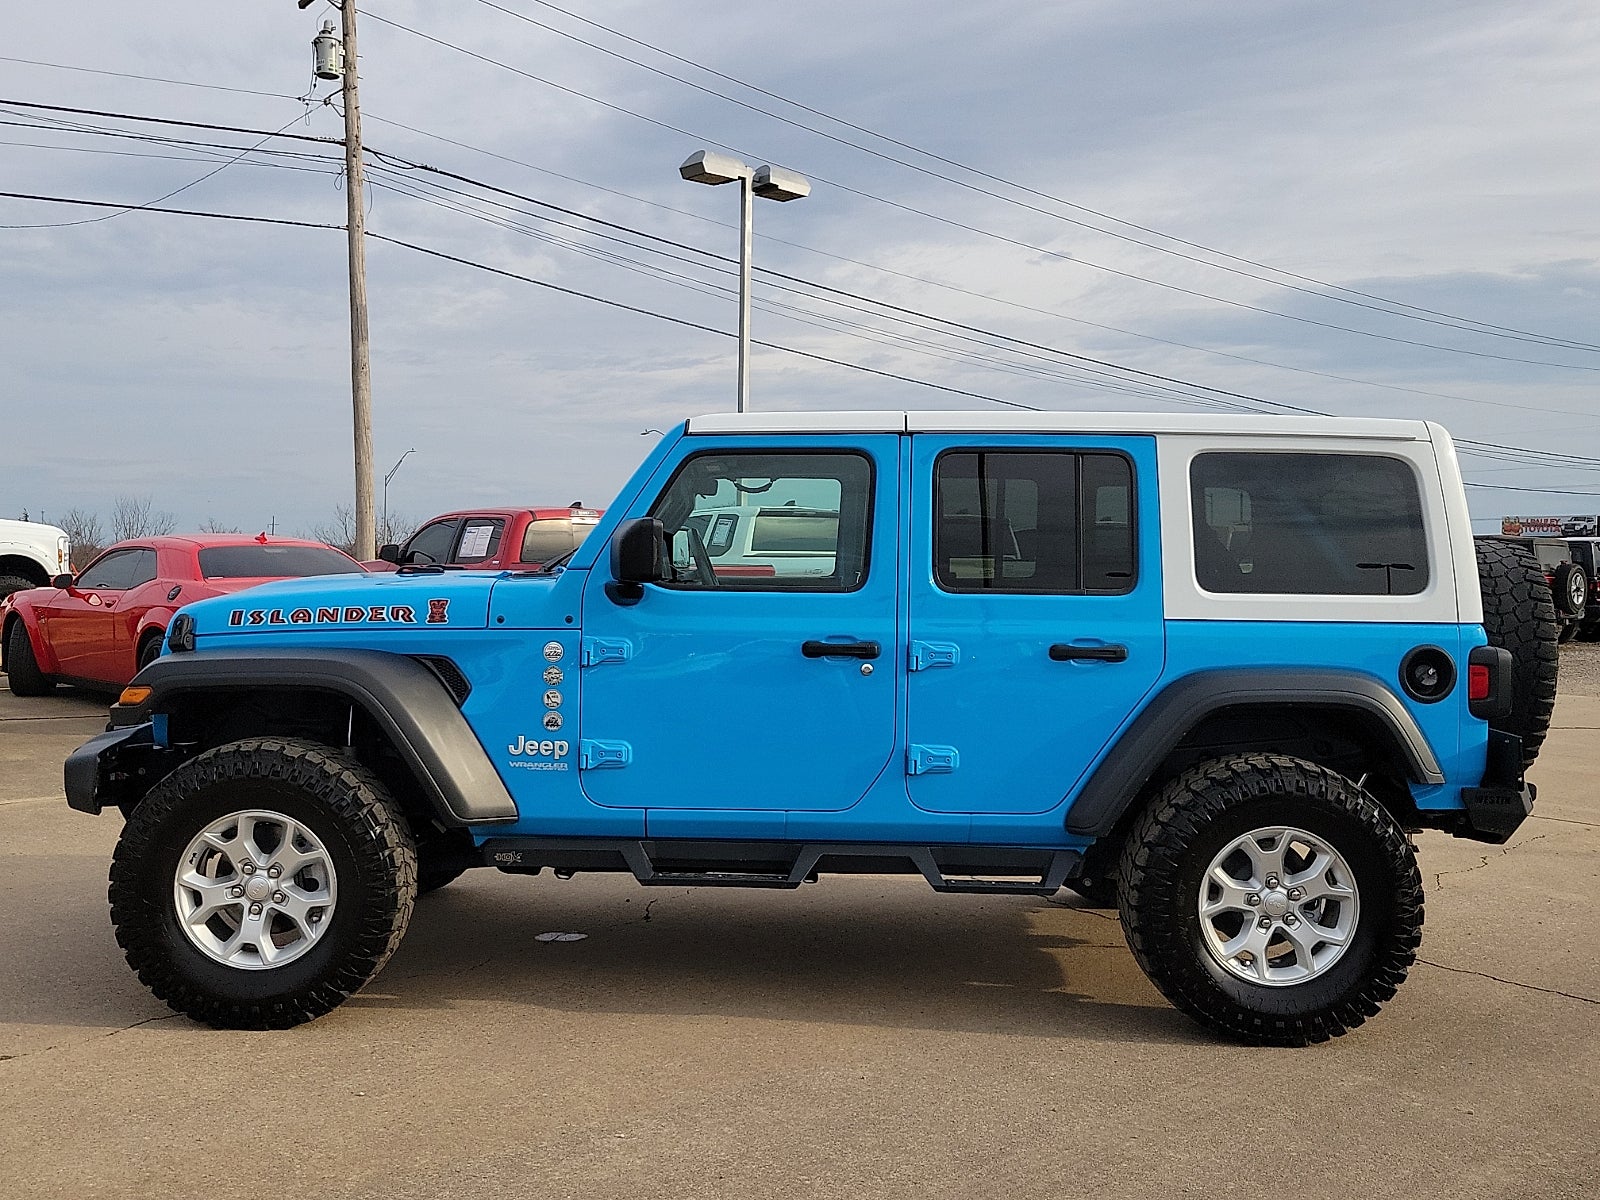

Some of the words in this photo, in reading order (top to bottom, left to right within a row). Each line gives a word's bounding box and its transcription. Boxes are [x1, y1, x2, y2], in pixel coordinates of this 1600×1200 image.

[1523, 525, 1561, 533] TOYOTA
[228, 605, 417, 627] ISLANDER
[508, 735, 569, 760] Jeep
